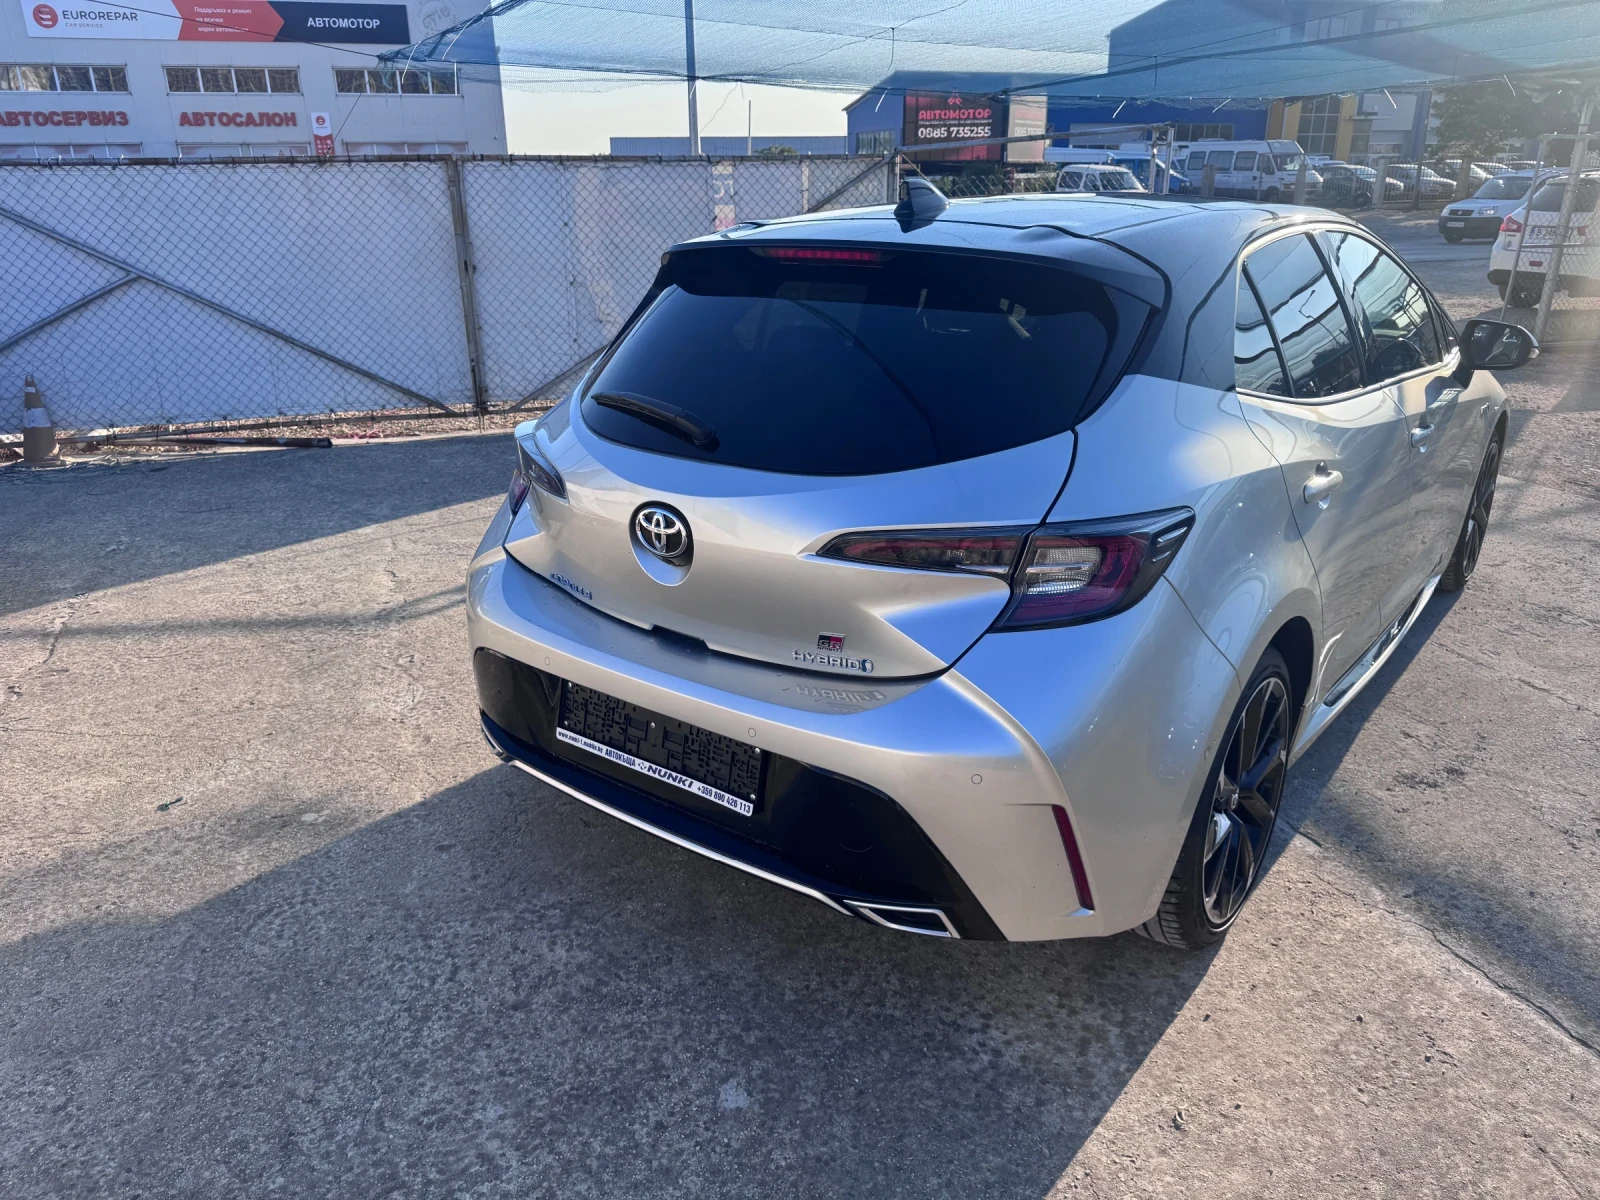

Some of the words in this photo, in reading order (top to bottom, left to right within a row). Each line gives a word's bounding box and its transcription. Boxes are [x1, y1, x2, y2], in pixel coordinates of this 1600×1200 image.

[62, 10, 139, 21] EUROREPAR
[307, 17, 381, 29] АВТОМОТОР
[179, 111, 298, 127] АВТОСАЛОН
[918, 108, 992, 120] АВТОМОТОР
[918, 127, 948, 138] 0885
[950, 126, 992, 138] 735255
[818, 639, 842, 649] GR
[792, 650, 860, 671] HYBRID
[605, 748, 636, 767] АВТОКЪЩА
[647, 764, 694, 789] NUNKI
[697, 785, 713, 798] +359
[713, 791, 726, 803] 890
[726, 796, 738, 809] 426
[739, 801, 751, 814] 113
